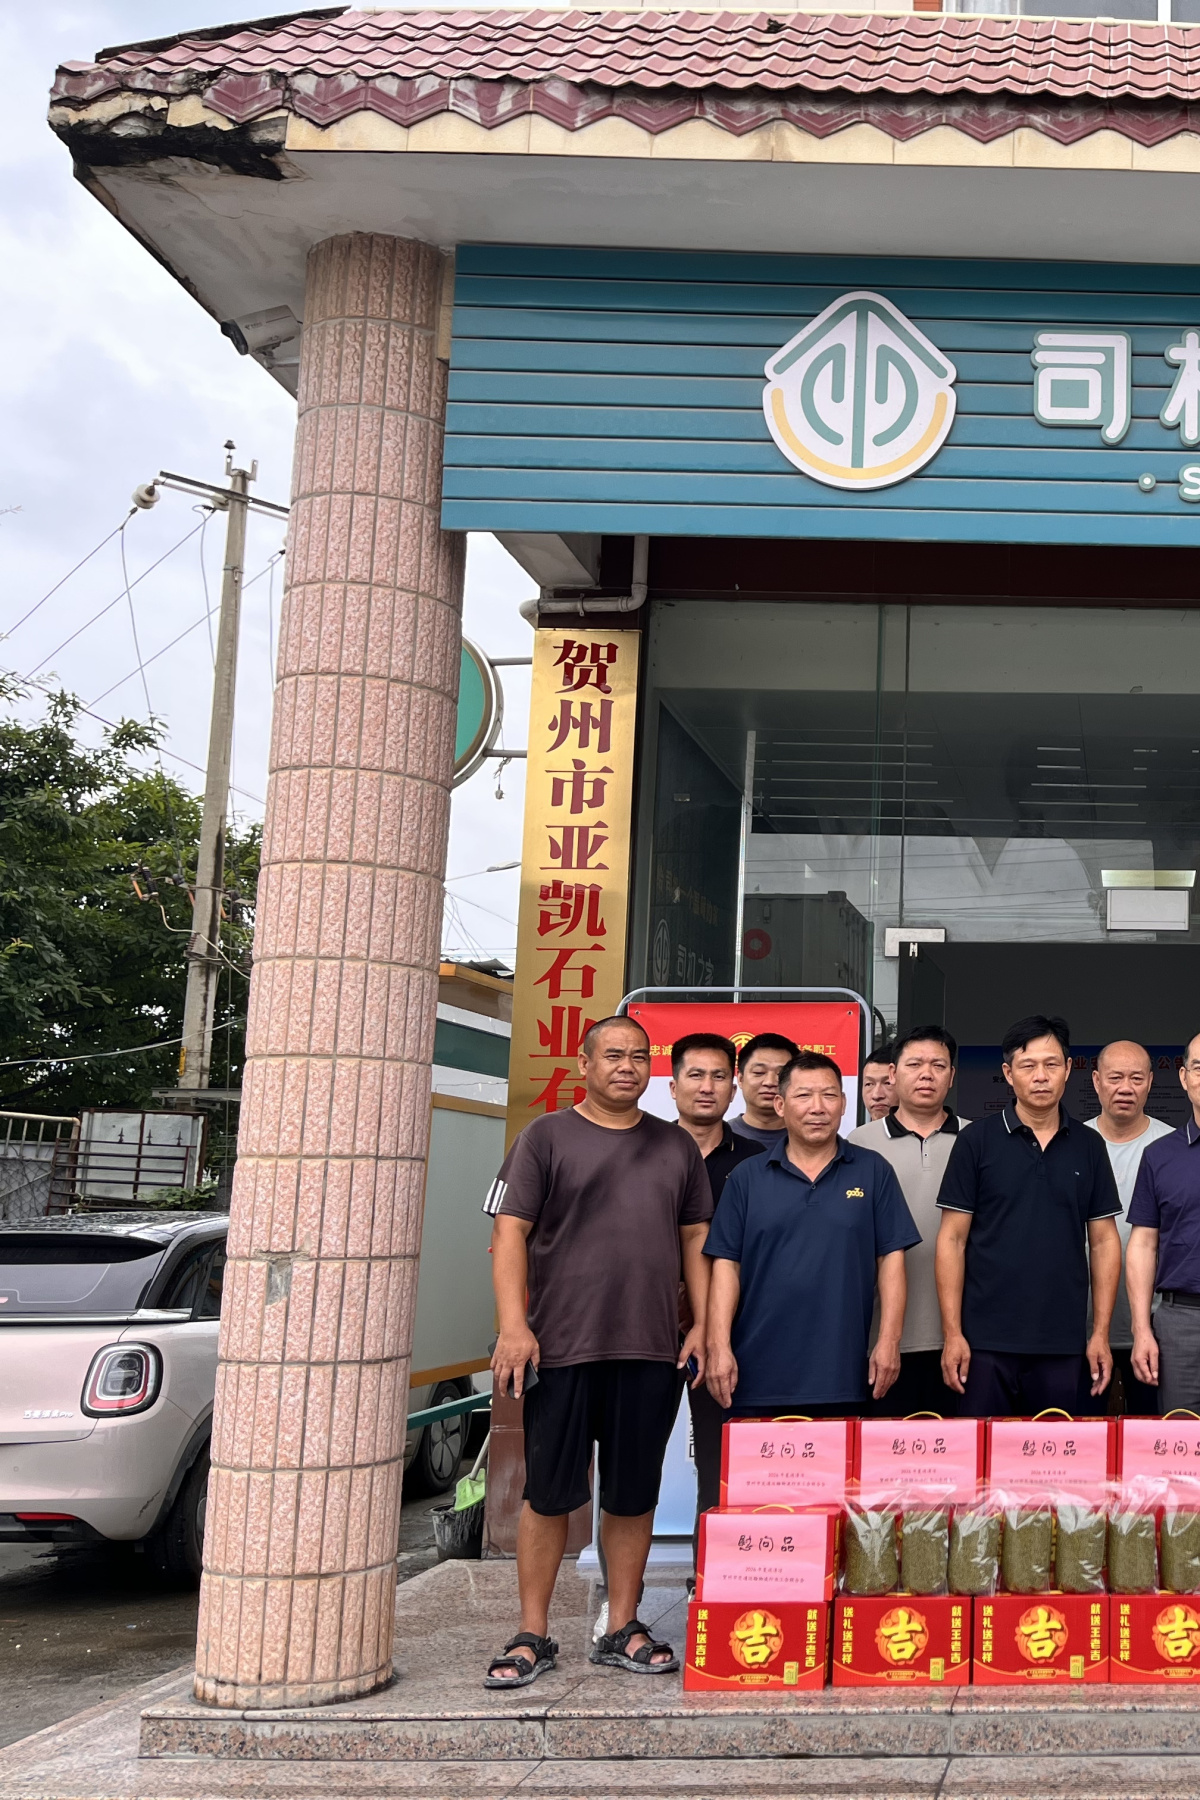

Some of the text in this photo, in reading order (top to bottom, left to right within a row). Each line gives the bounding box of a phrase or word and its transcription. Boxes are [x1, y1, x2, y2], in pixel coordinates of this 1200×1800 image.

[761, 1441, 816, 1459] 慰问品
[892, 1438, 947, 1455] 慰问品
[1022, 1440, 1077, 1456] 慰问品
[738, 1534, 795, 1553] 慰问品
[694, 1609, 708, 1667] 送礼送吉祥
[735, 1612, 778, 1665] 吉
[805, 1609, 818, 1668] 就送王老吉
[841, 1606, 854, 1664] 送礼送吉祥
[880, 1609, 923, 1661] 吉
[950, 1605, 962, 1664] 就送王老吉
[981, 1605, 993, 1663] 送礼送吉祥
[1020, 1608, 1063, 1659] 吉
[1090, 1603, 1102, 1661] 就送王老吉
[1118, 1603, 1130, 1661] 送礼送吉祥
[1157, 1607, 1200, 1658] 吉
